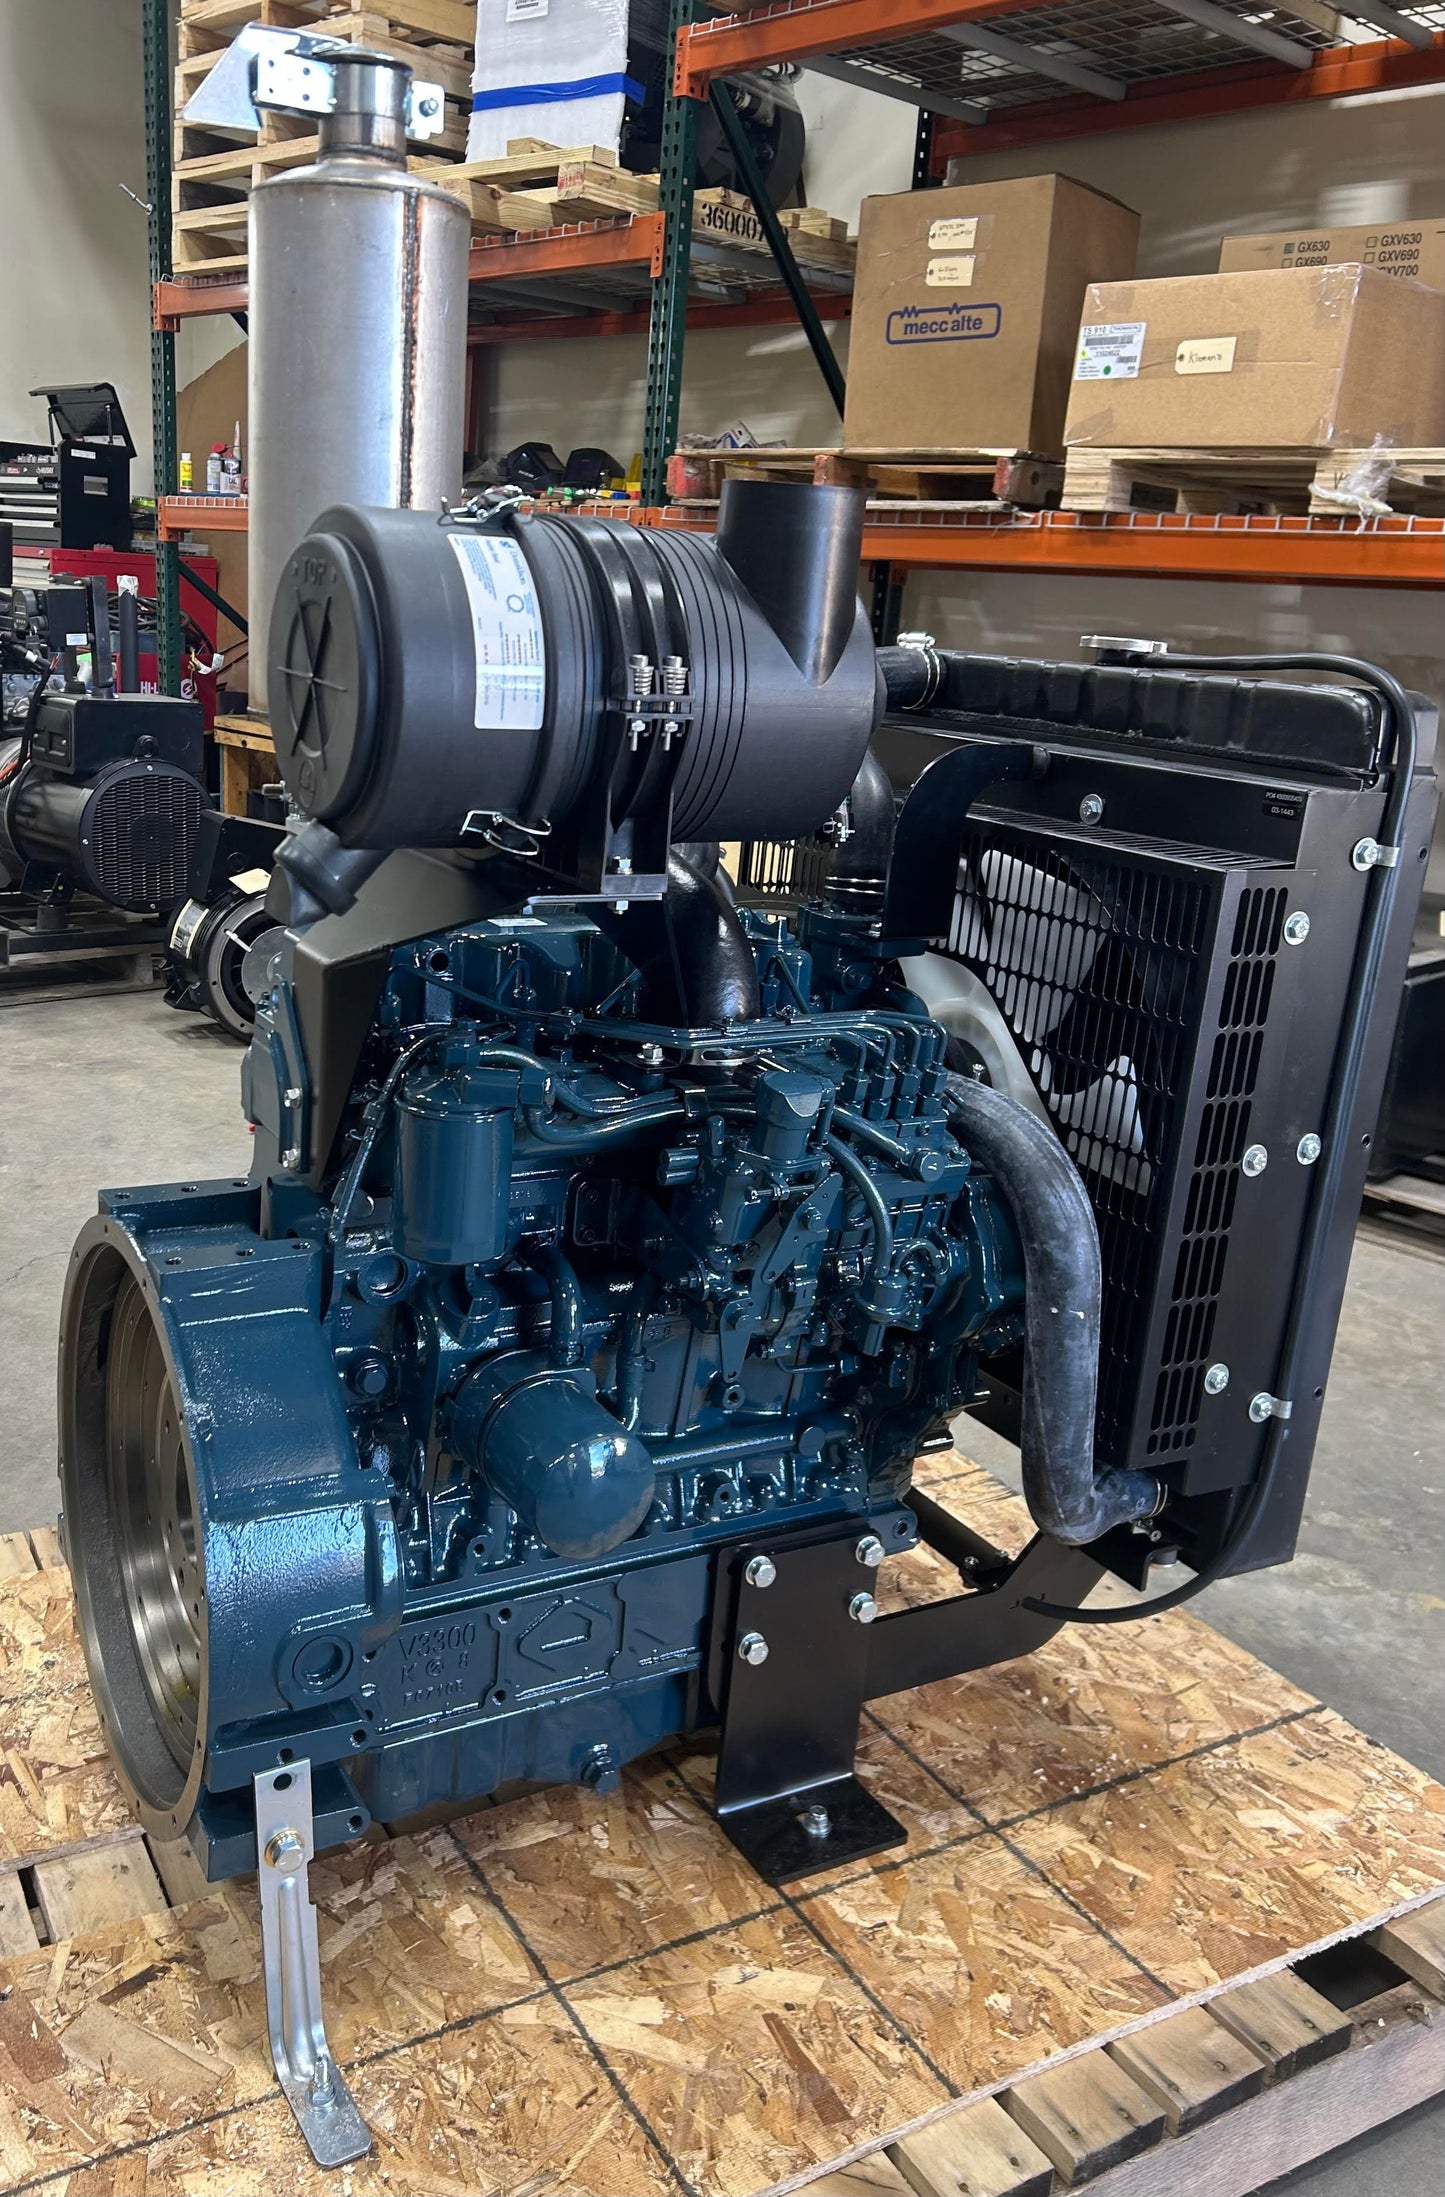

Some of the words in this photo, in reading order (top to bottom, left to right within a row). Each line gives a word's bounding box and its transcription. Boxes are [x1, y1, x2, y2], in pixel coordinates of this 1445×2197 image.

[1381, 232, 1422, 247] GXV630
[1297, 240, 1331, 253] GX630
[1295, 256, 1328, 267] GX690
[1378, 249, 1420, 262] GXV690
[1377, 264, 1419, 277] XV700
[1083, 327, 1093, 335] TS
[1094, 326, 1107, 334] 910
[303, 557, 328, 586] TOP
[399, 1621, 476, 1661] V3300
